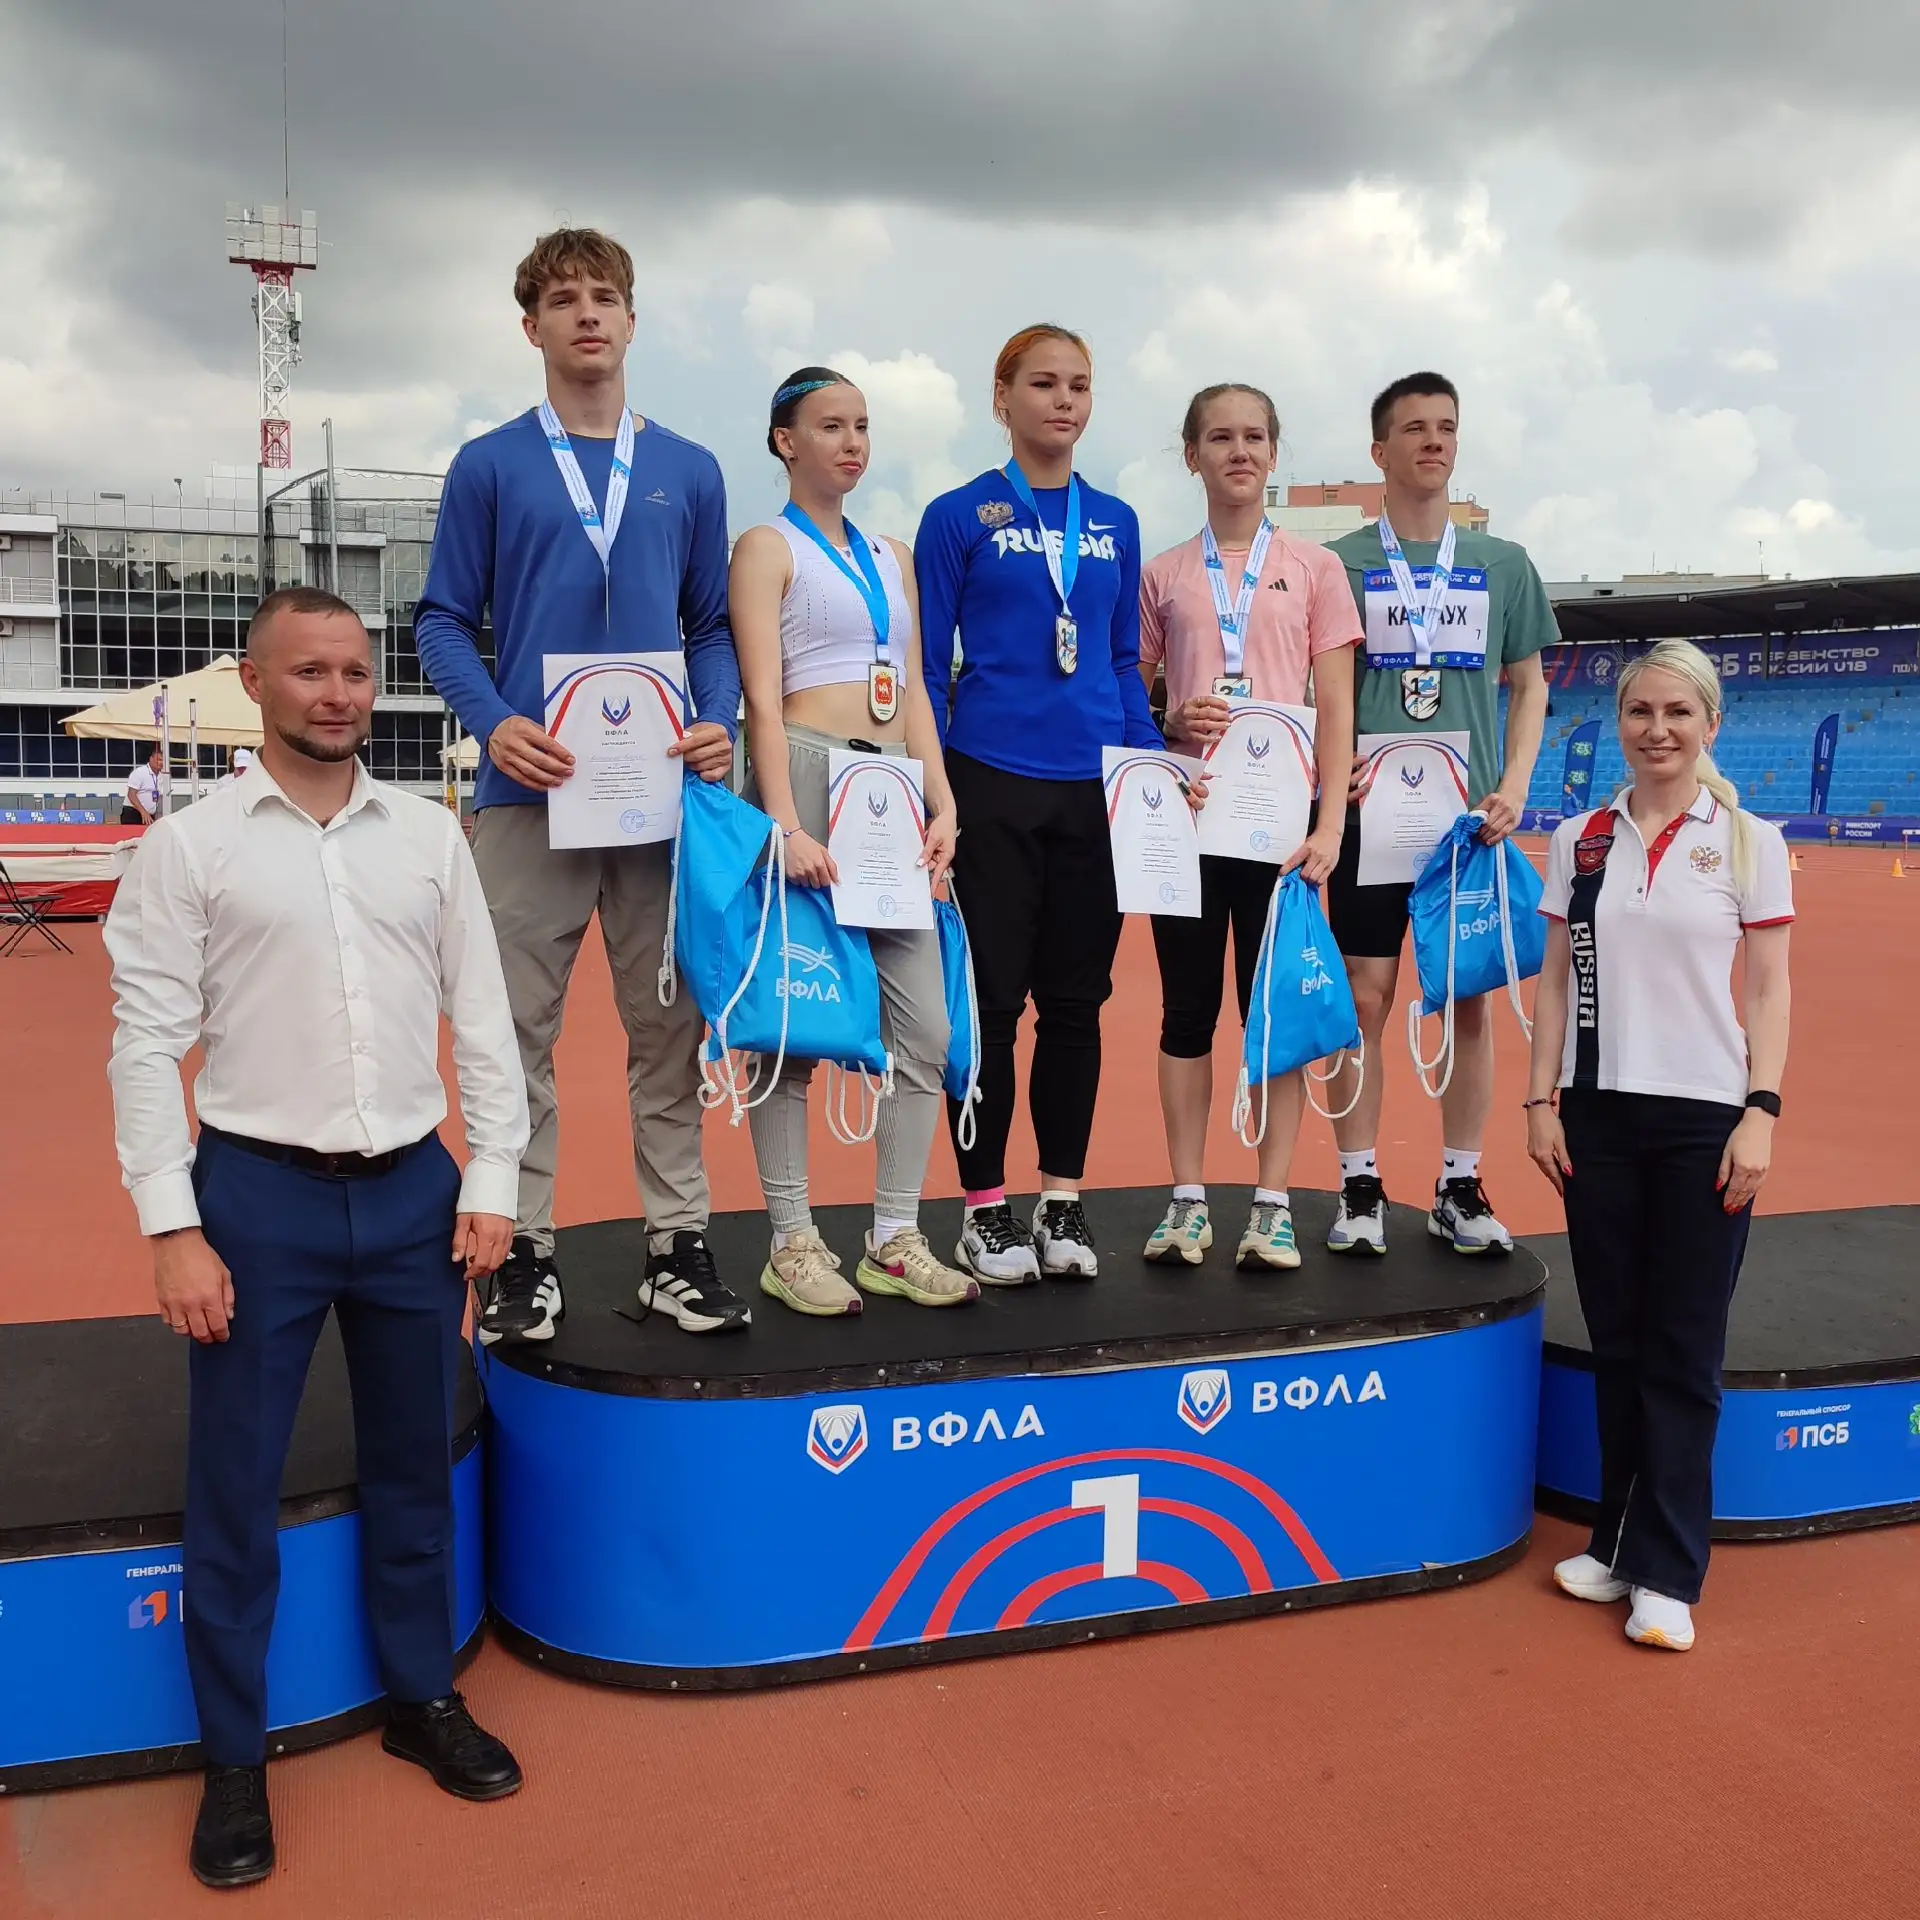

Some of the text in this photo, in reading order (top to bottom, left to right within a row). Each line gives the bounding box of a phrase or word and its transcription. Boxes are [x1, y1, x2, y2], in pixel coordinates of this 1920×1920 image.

[1475, 628, 1481, 641] 7
[1833, 660, 1868, 672] U18
[1570, 921, 1594, 1028] RUSSIA
[775, 977, 841, 1003] ВФЛА
[1252, 1370, 1387, 1414] ВФЛА
[892, 1404, 1046, 1452] ВФЛА
[1802, 1421, 1849, 1448] ПСБ
[1071, 1473, 1140, 1579] 1
[126, 1563, 184, 1578] ГЕНЕРАЛЬ
